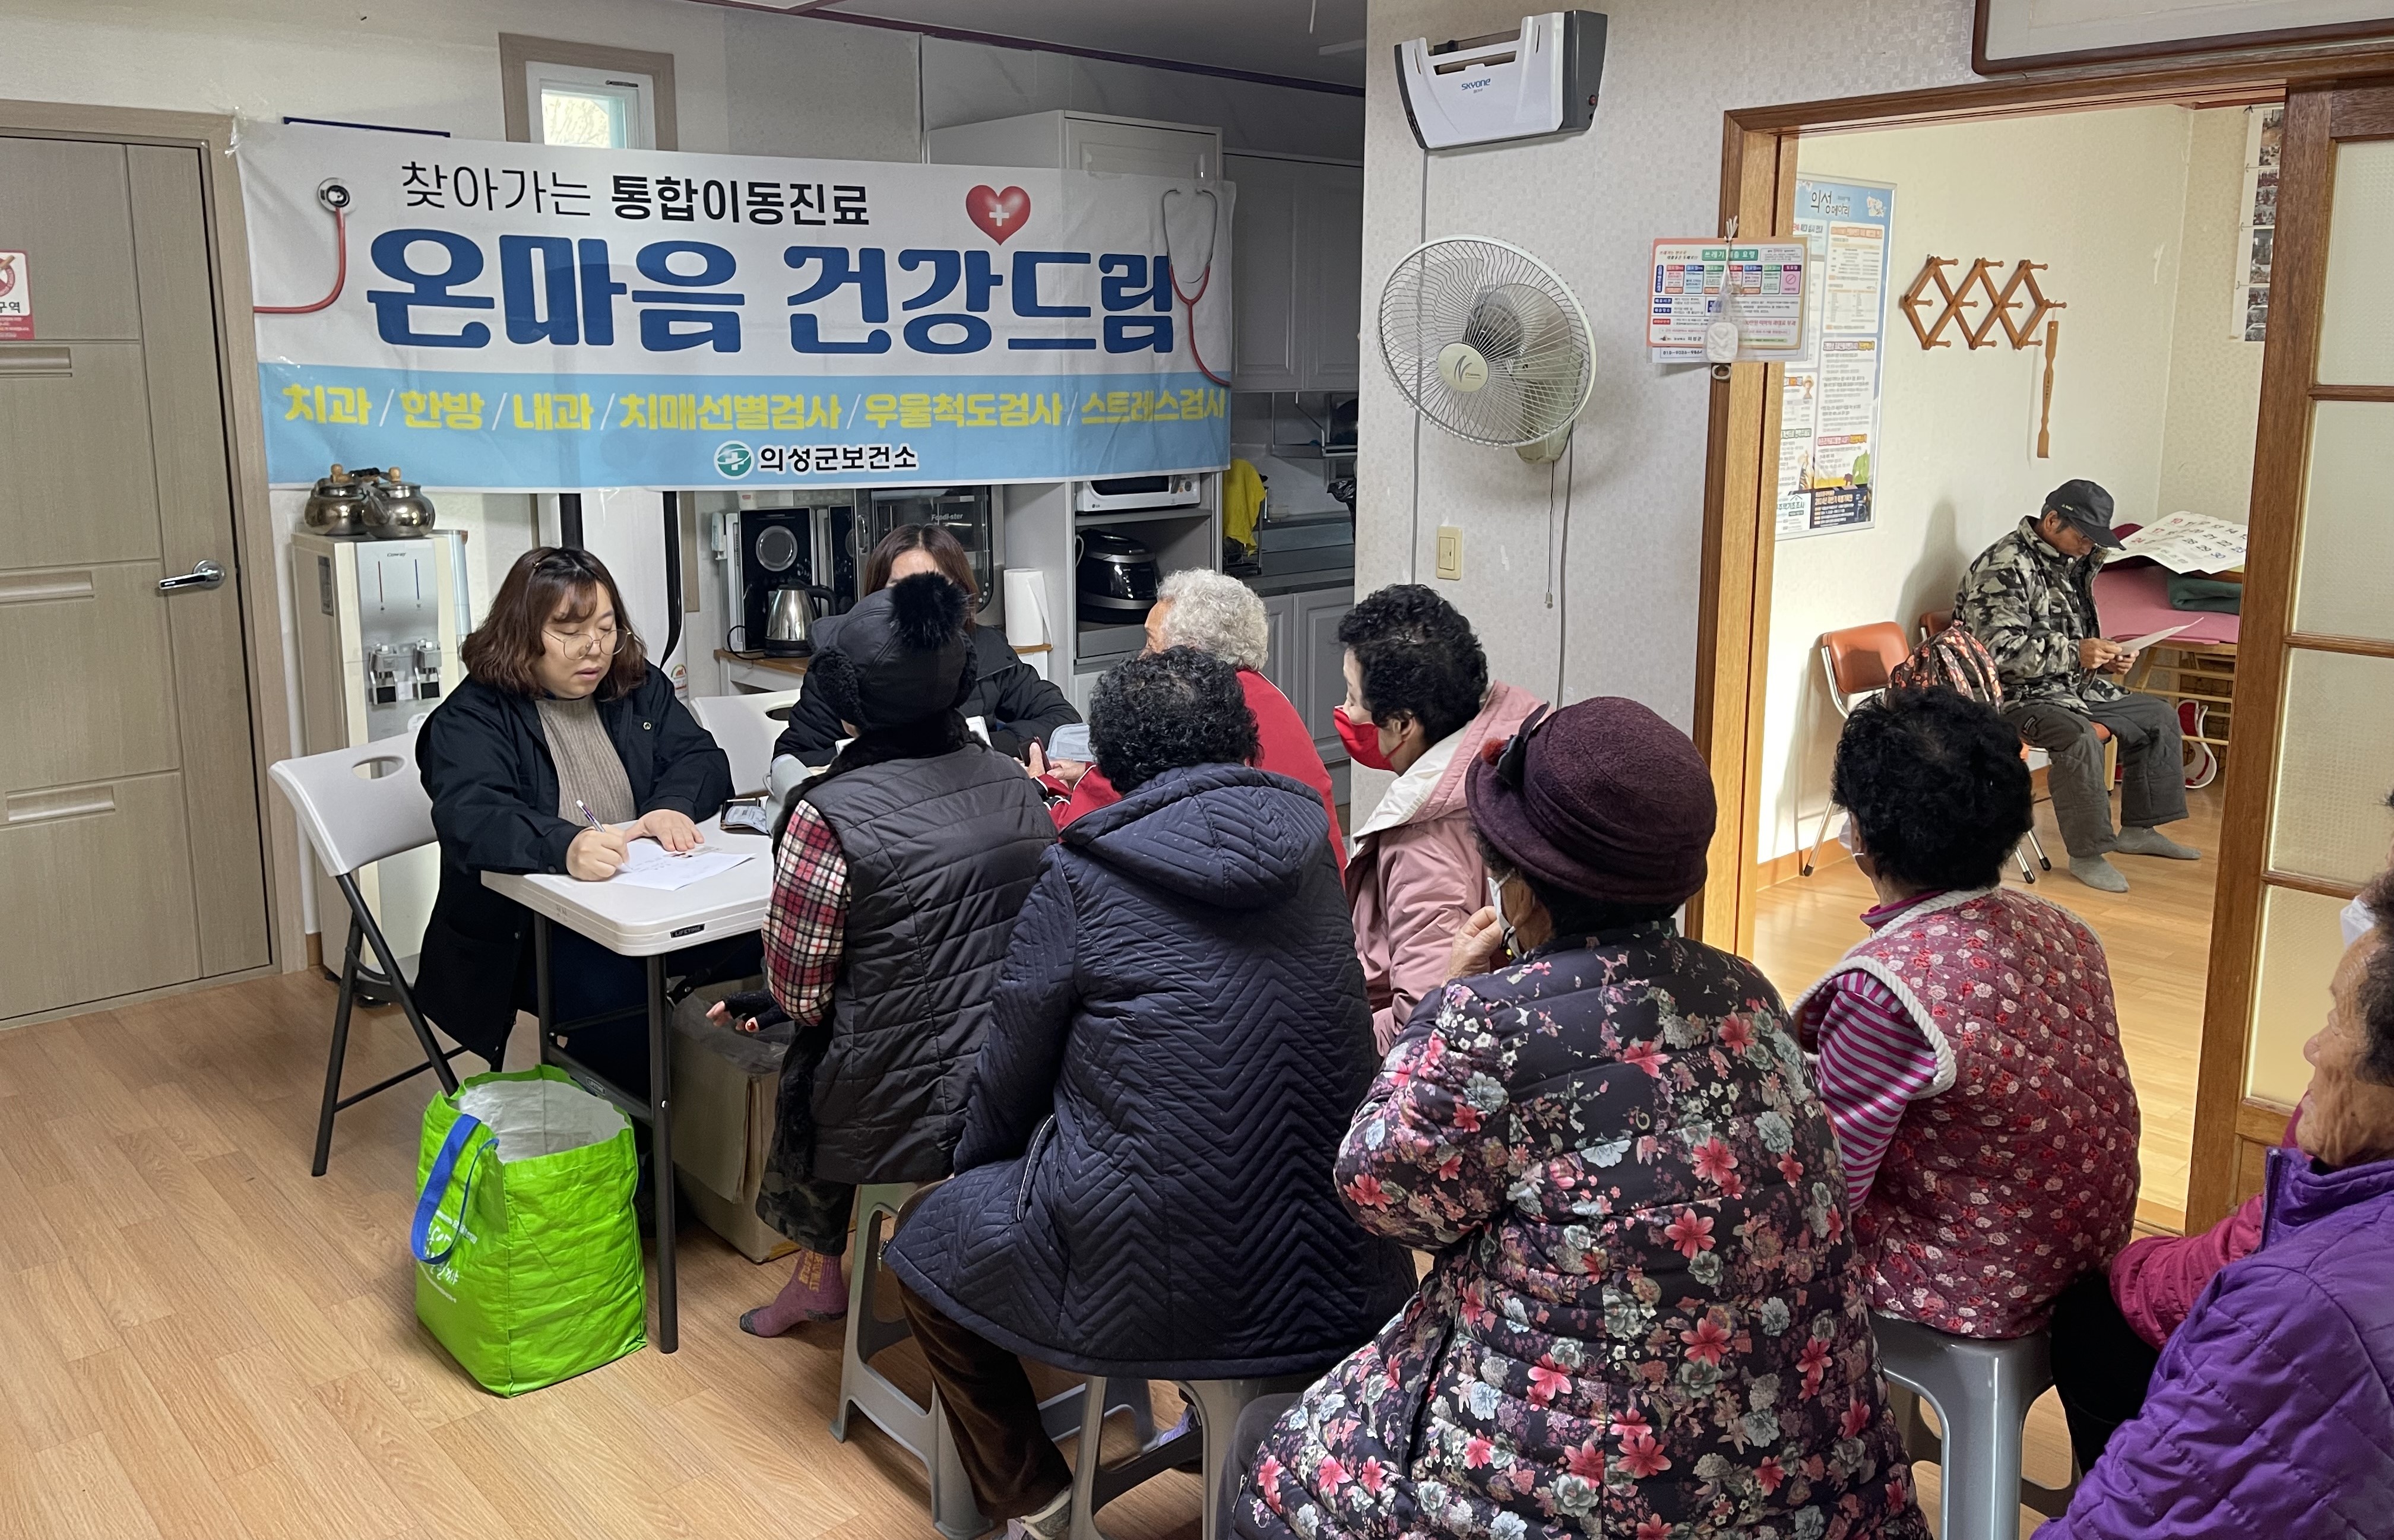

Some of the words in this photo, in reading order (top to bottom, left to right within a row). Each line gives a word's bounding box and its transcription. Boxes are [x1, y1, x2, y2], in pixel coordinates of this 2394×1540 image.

[401, 160, 592, 216] 찾아가는
[611, 174, 870, 226] 통합이동진료
[366, 228, 745, 353] 온마음
[783, 246, 1174, 355] 건강드림
[283, 384, 372, 426] 치과
[399, 391, 485, 430] 한방
[512, 392, 594, 431] 내과
[619, 393, 842, 430] 치매선별검사
[864, 392, 1063, 429] 우울척도검사
[760, 445, 917, 472] 의성군보건소
